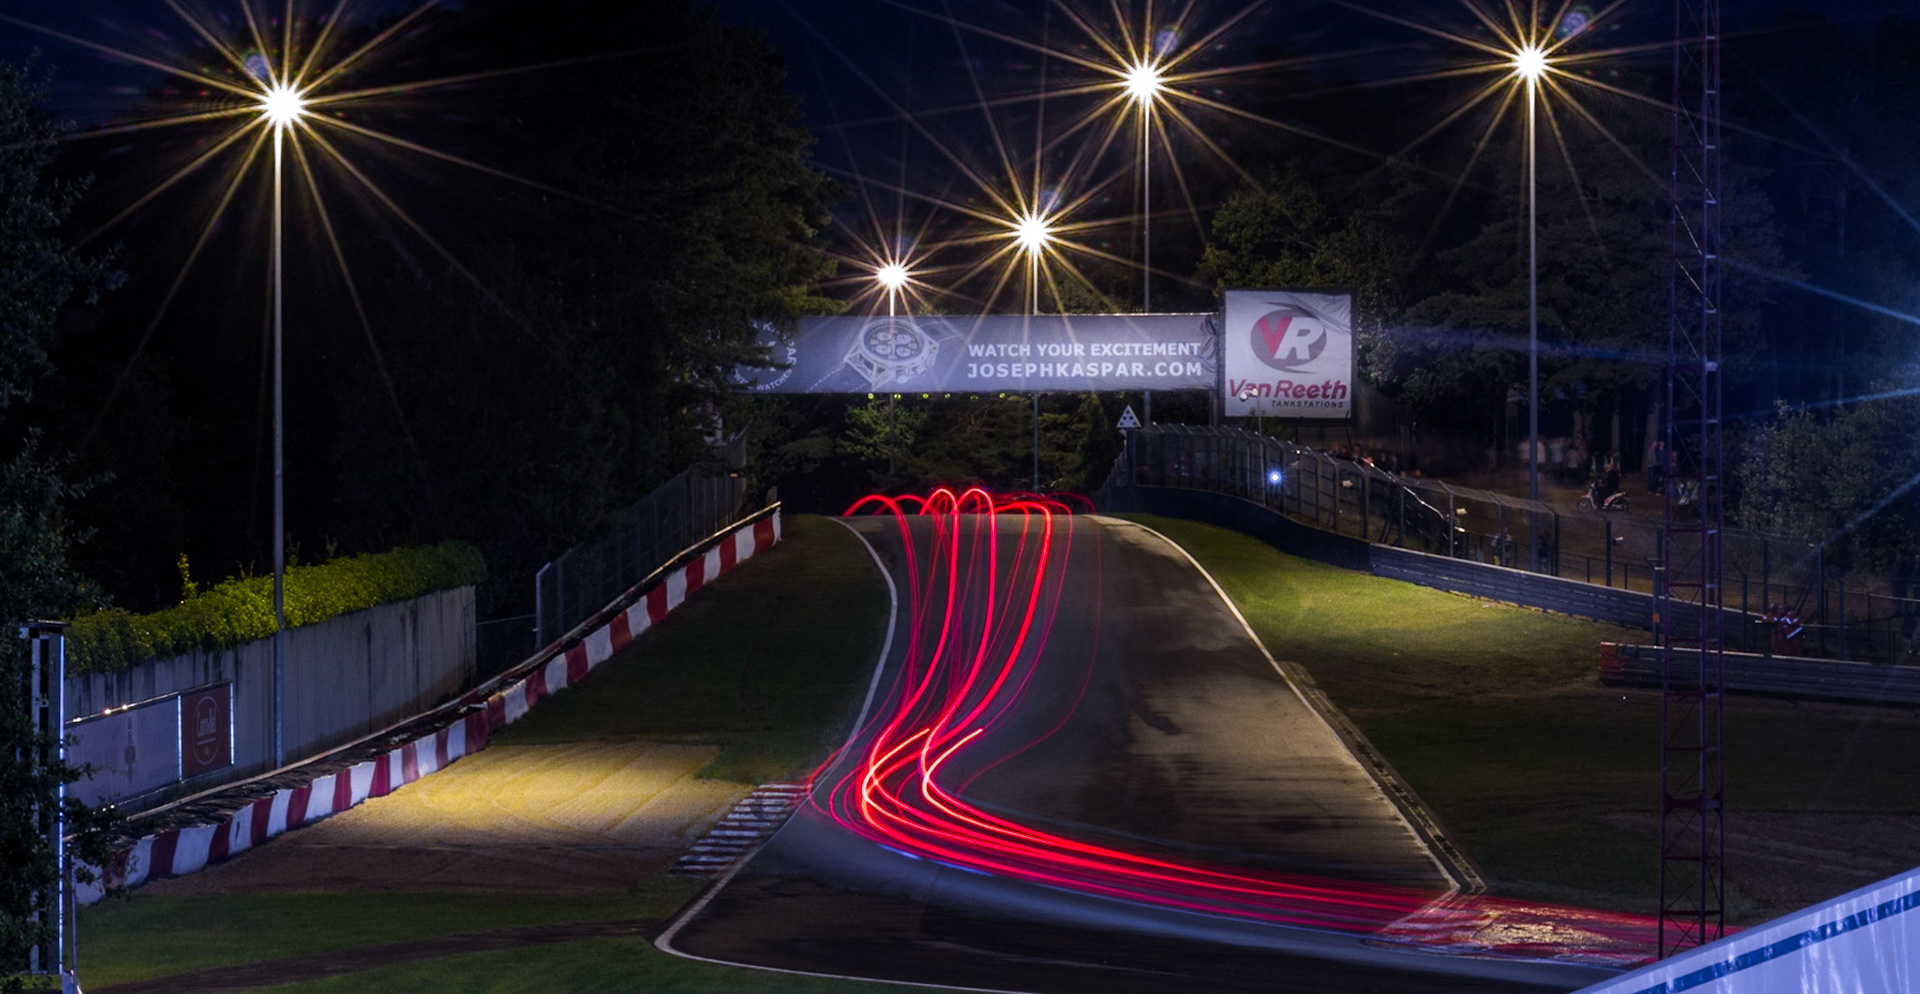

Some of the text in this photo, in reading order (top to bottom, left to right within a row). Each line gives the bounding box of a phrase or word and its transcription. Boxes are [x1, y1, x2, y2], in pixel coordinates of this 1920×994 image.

[968, 342, 1201, 357] WATCH YOUR EXCITEMENT
[967, 362, 1202, 378] JOSEPHKASPAR.COM
[1273, 379, 1347, 399] Reeth
[1271, 400, 1344, 408] TANKSTATIONS
